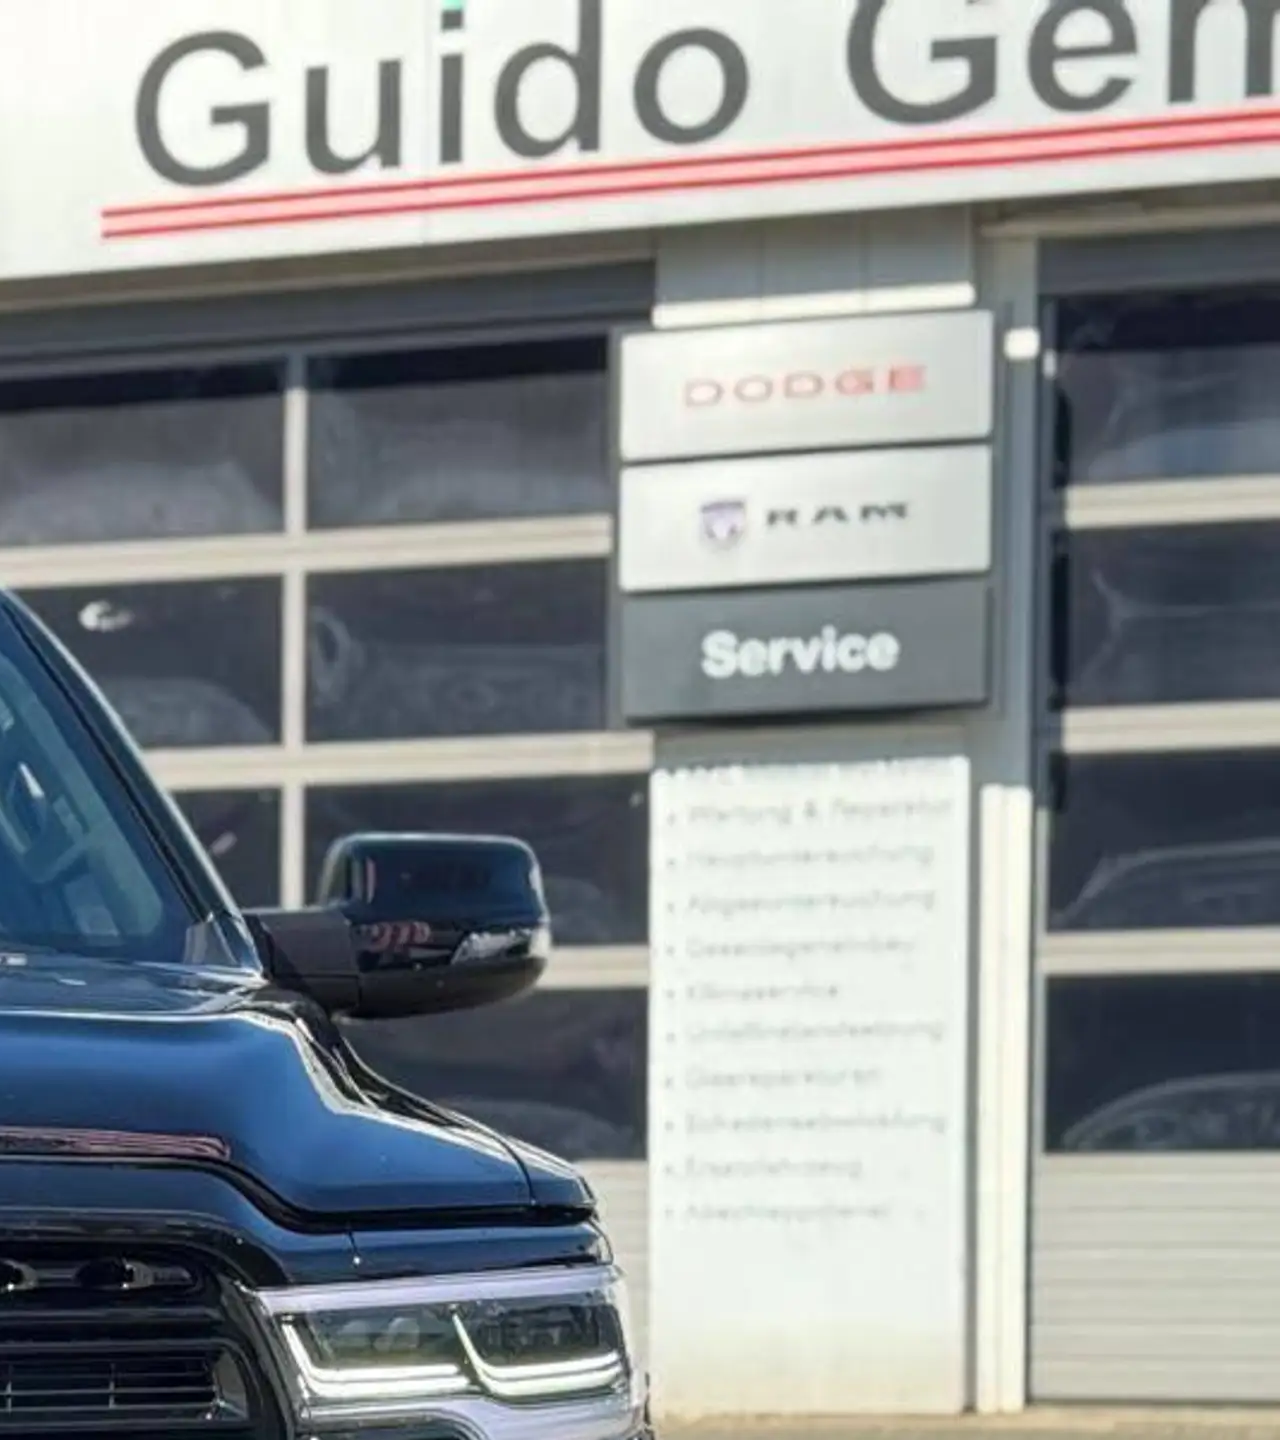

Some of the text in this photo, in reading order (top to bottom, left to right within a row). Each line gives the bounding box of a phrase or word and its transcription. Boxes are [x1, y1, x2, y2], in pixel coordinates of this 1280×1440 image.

[134, 0, 749, 187] Guido
[684, 364, 927, 407] DODGE
[765, 502, 908, 527] RAM
[700, 623, 902, 680] Service
